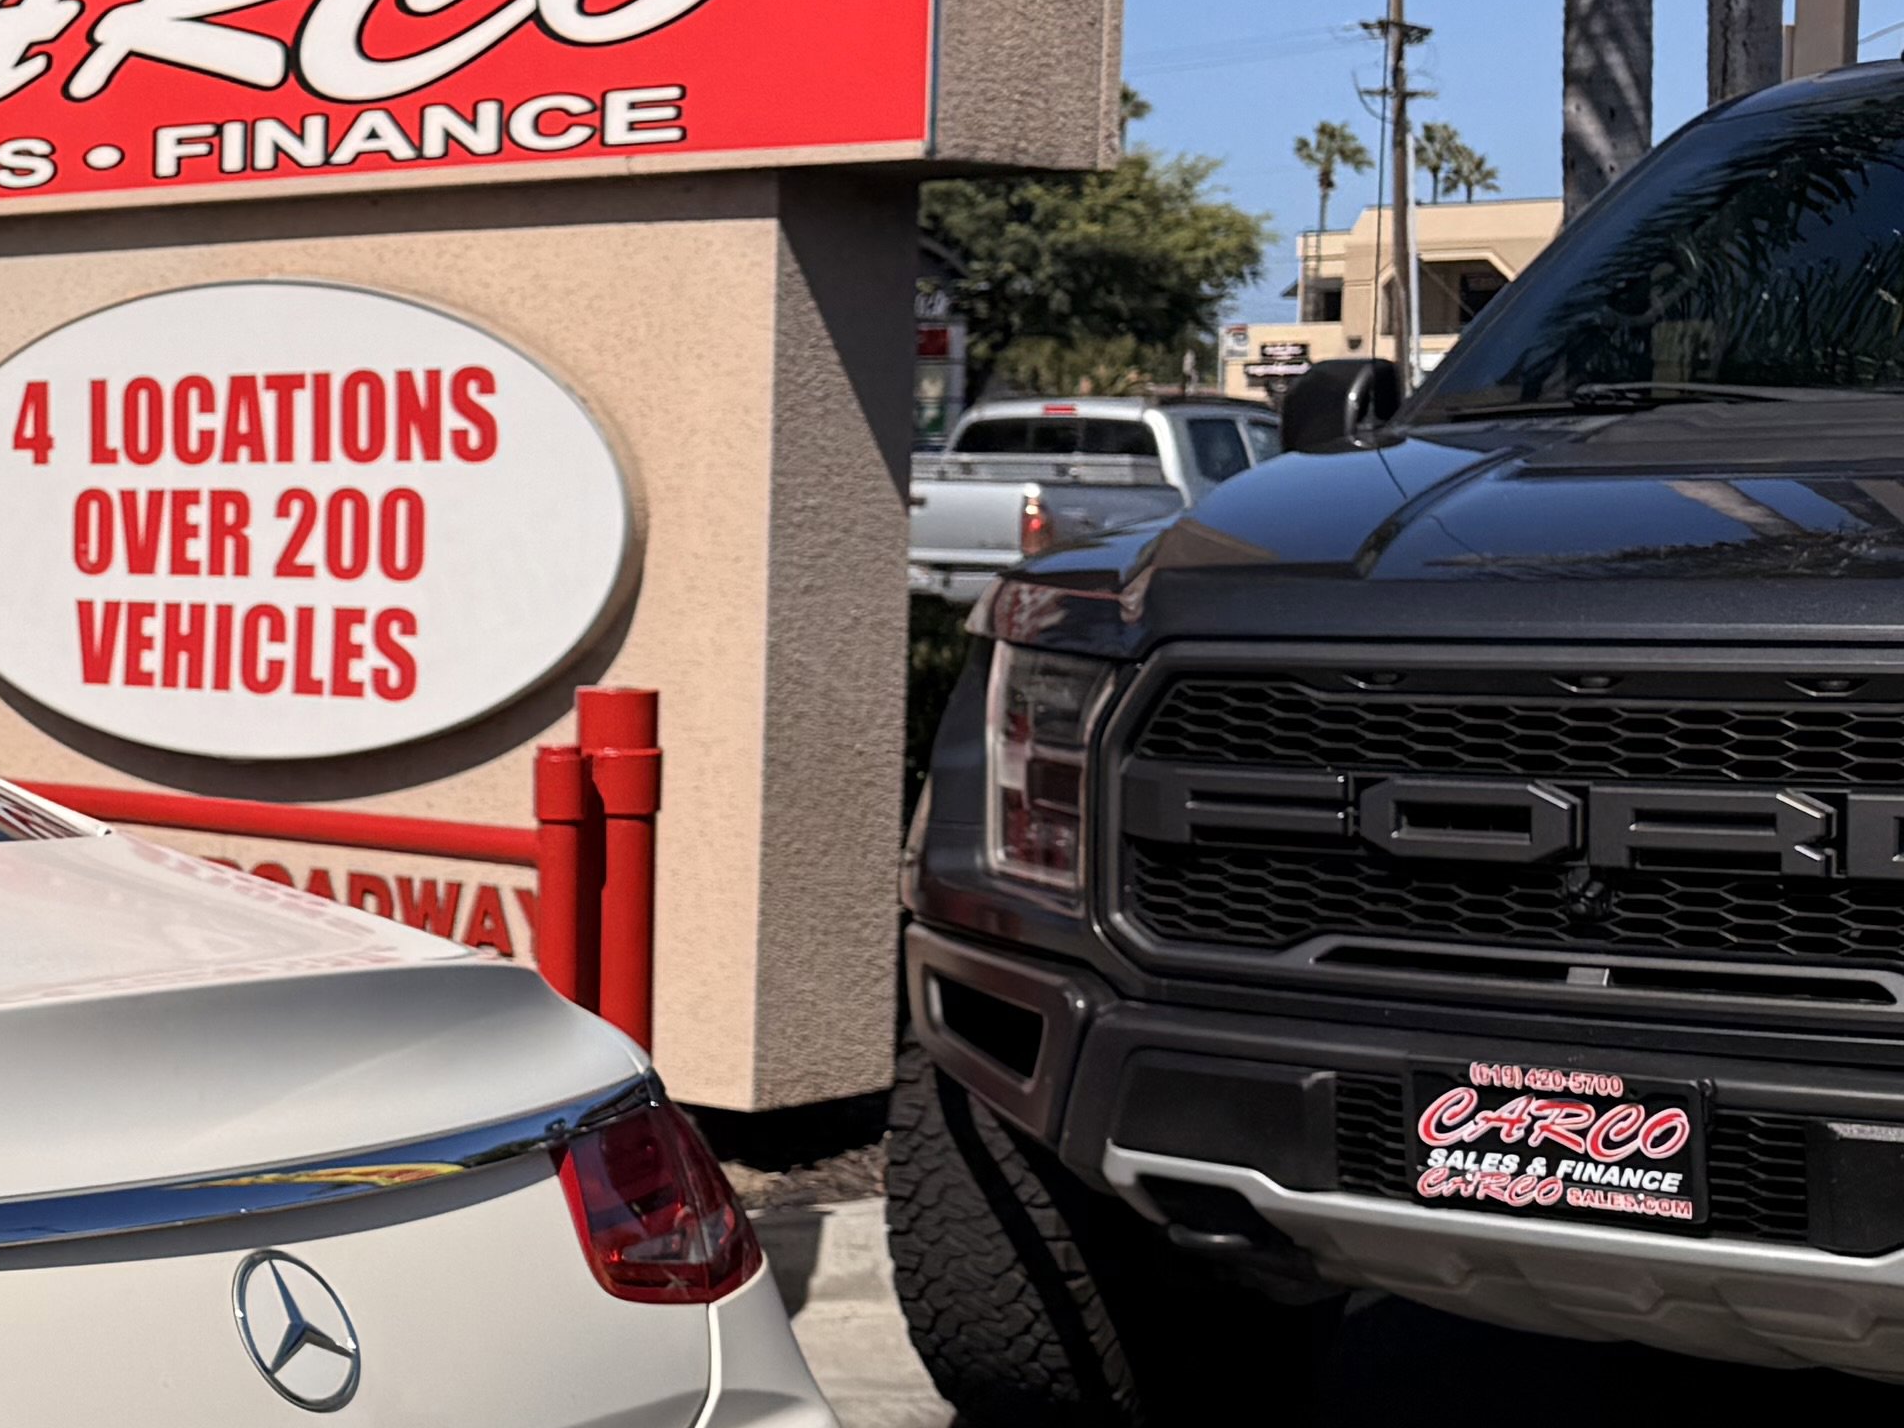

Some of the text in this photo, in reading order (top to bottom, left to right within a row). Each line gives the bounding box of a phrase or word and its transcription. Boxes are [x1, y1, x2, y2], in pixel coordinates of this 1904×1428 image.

[153, 84, 686, 178] FINANCE
[11, 365, 499, 466] 4 LOCATIONS
[73, 485, 426, 582] OVER 200
[76, 597, 419, 703] VEHICLES
[1127, 764, 1904, 878] FOR
[1418, 1086, 1690, 1163] CARCO
[1469, 1061, 1624, 1098] (619) 420-5700
[1417, 1166, 1692, 1220] CARCO SALES.COM
[1427, 1147, 1683, 1194] SALES & FINANCE
